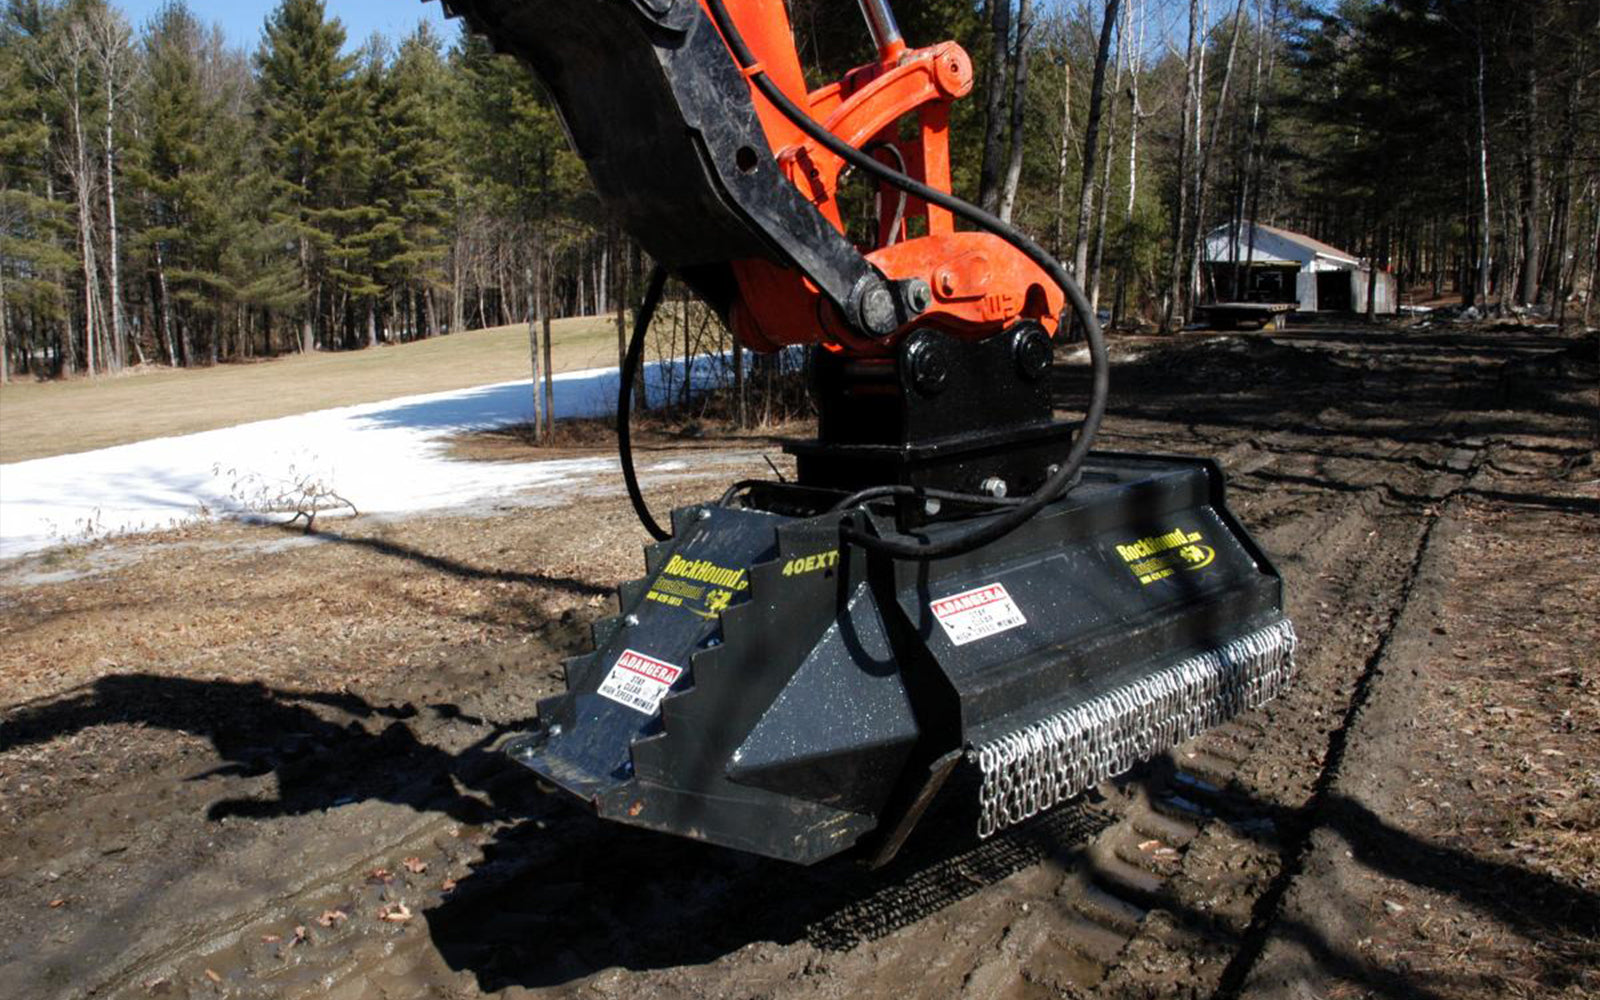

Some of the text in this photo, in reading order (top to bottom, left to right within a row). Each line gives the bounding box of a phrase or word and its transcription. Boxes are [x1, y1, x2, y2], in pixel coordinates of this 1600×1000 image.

[943, 589, 997, 613] DANGER
[968, 608, 987, 618] STAY
[971, 614, 993, 626] CLEAR
[625, 655, 669, 679] DANGER
[630, 675, 646, 686] STAY
[622, 682, 642, 694] CLEAR
[614, 689, 633, 702] SPEED
[631, 697, 654, 711] MOWER
